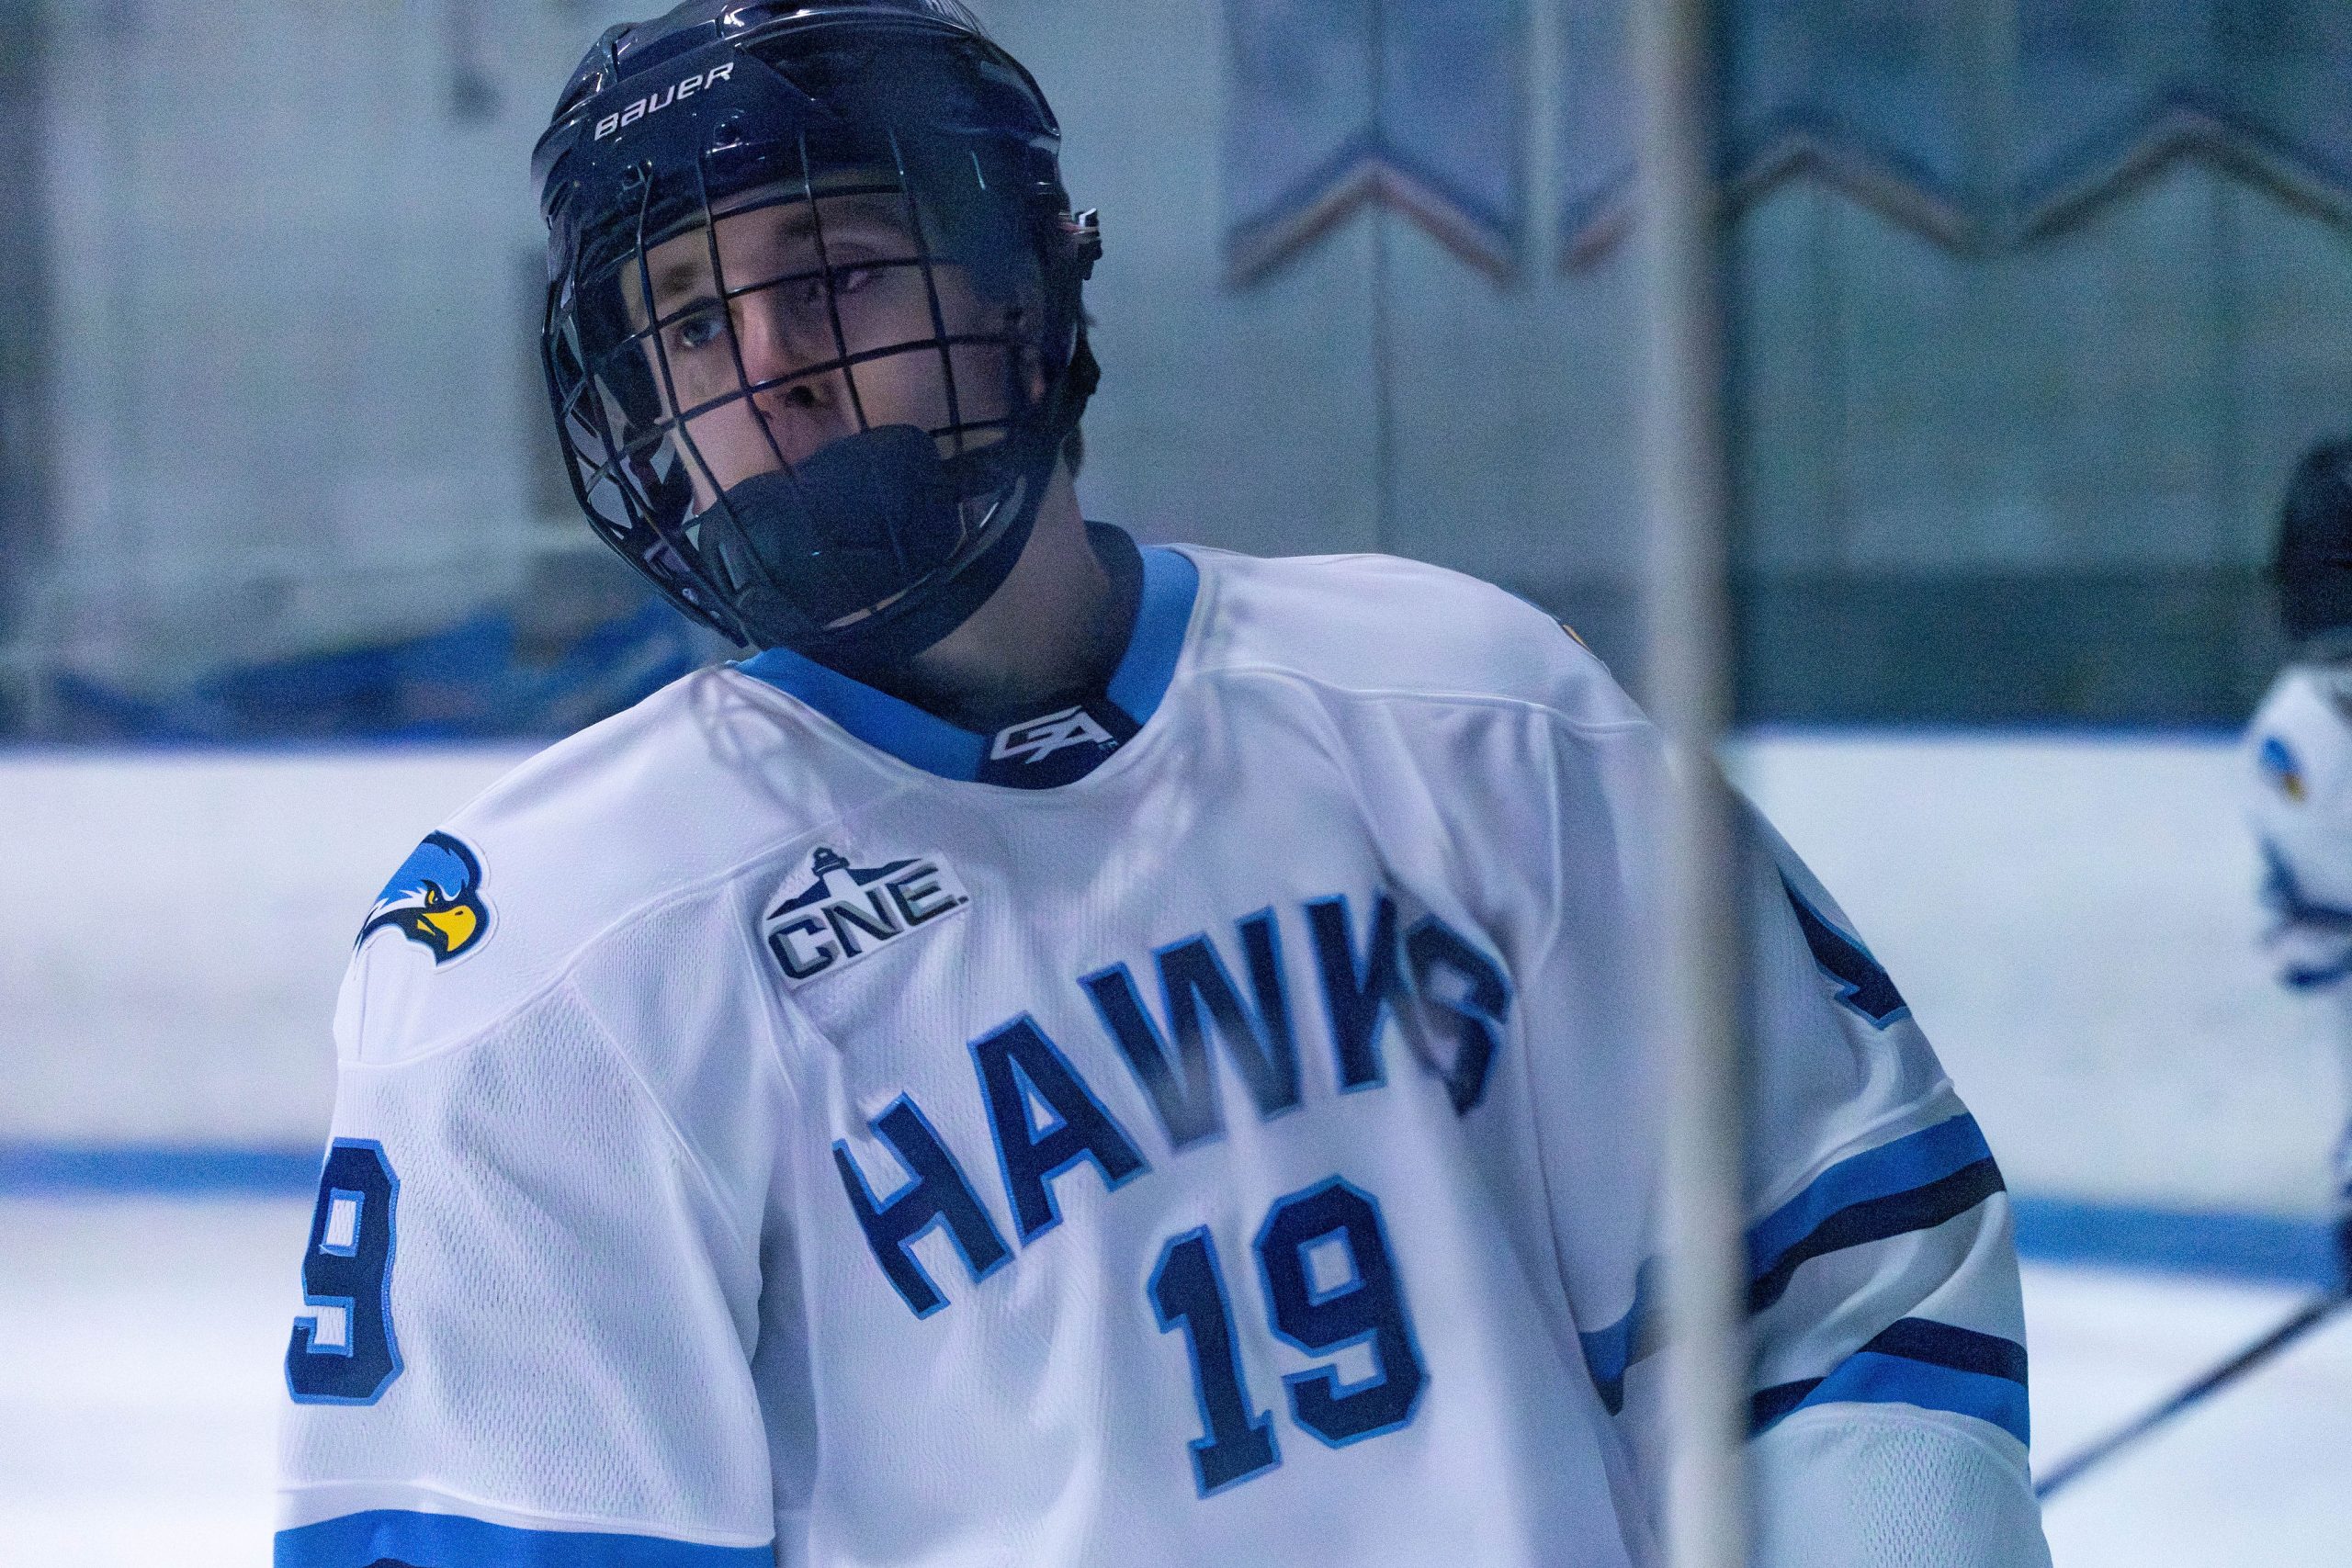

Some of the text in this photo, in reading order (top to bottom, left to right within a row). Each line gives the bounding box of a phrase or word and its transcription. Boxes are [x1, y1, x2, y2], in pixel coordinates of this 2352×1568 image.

[593, 60, 735, 141] BAUER
[832, 893, 1514, 1320] HAWKS
[1147, 1175, 1431, 1499] 19
